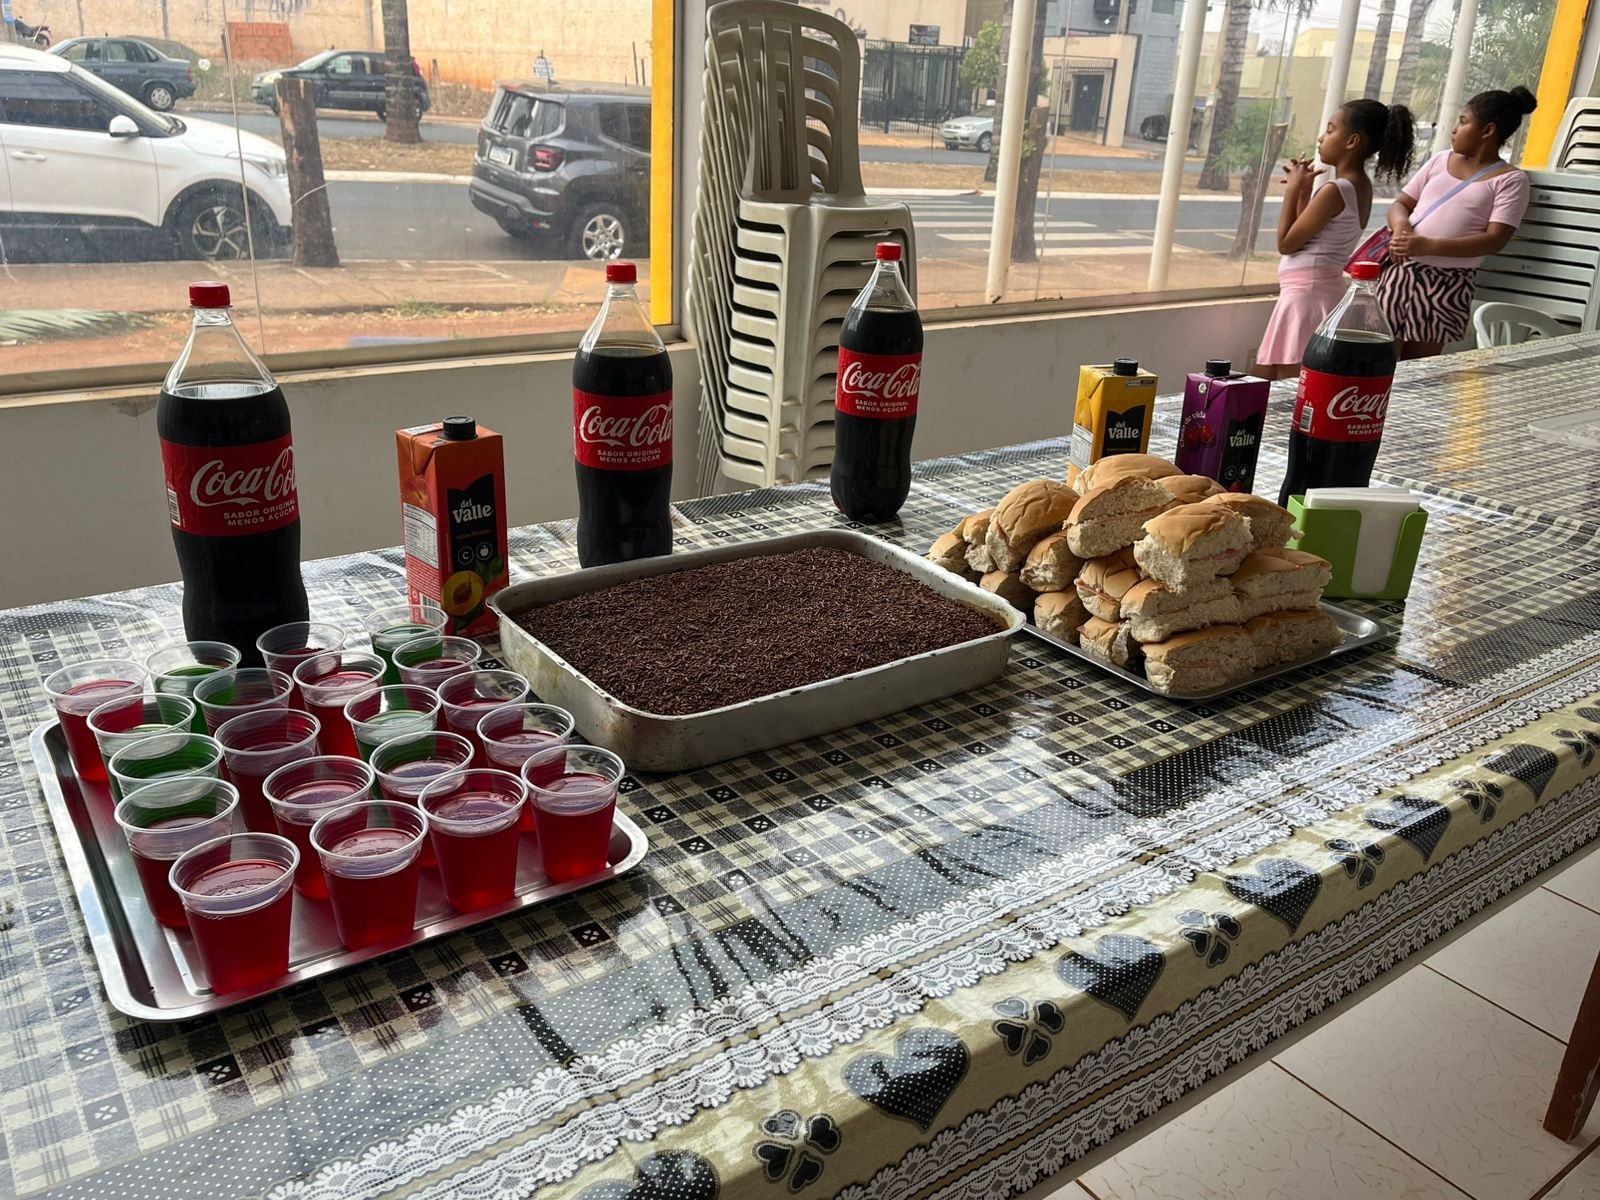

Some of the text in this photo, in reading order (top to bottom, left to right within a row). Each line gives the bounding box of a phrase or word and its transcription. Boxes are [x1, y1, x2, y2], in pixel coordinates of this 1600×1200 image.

[1108, 427, 1140, 439] Valle
[1229, 434, 1256, 447] Valle
[597, 448, 662, 457] SABOR ORIGINAL
[631, 454, 660, 464] AÇÚCAR
[223, 498, 296, 519] SABOR ORIGINAL
[460, 498, 472, 508] del
[227, 505, 295, 527] MENOS AÇÚCAR
[452, 504, 492, 523] Valle
